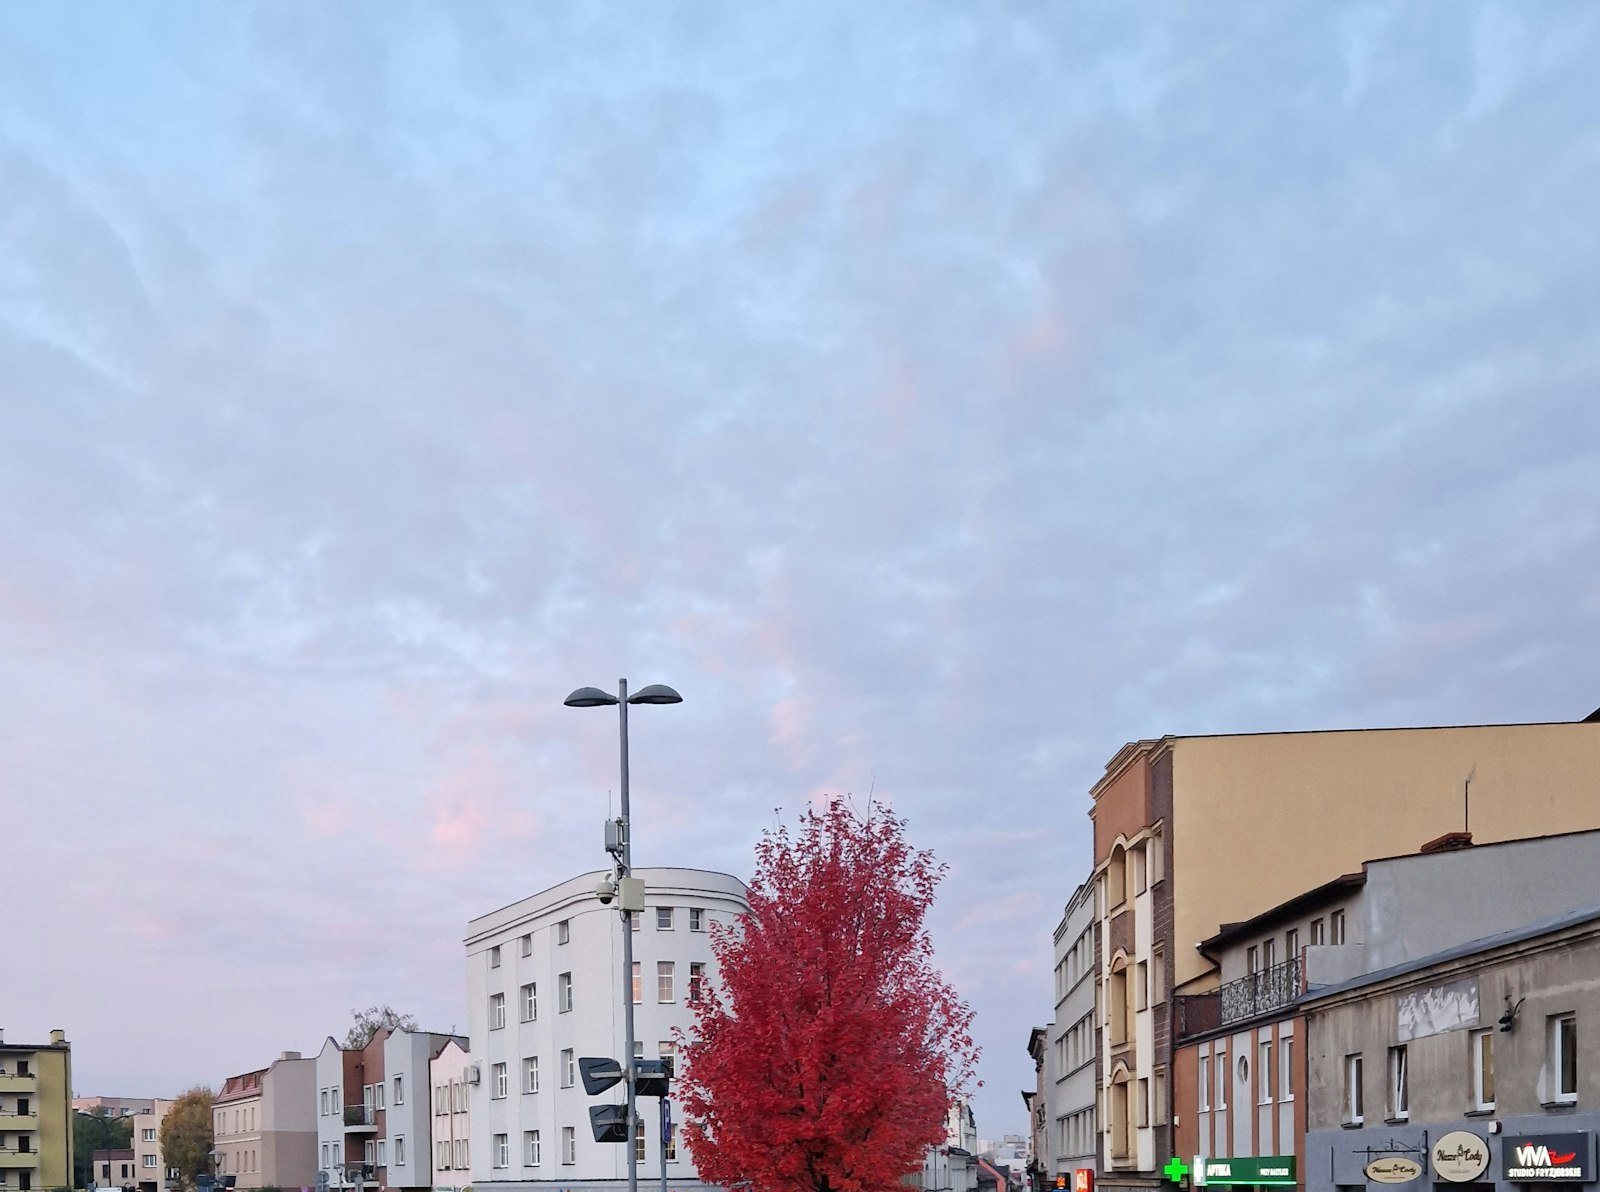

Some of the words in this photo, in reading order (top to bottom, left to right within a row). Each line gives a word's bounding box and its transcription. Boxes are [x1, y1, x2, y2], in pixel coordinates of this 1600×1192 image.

[1516, 1145, 1551, 1166] VIVA
[1206, 1164, 1231, 1176] APTEKA
[1508, 1168, 1535, 1178] STUDIO
[1536, 1167, 1581, 1178] FRYZJERSKIE
